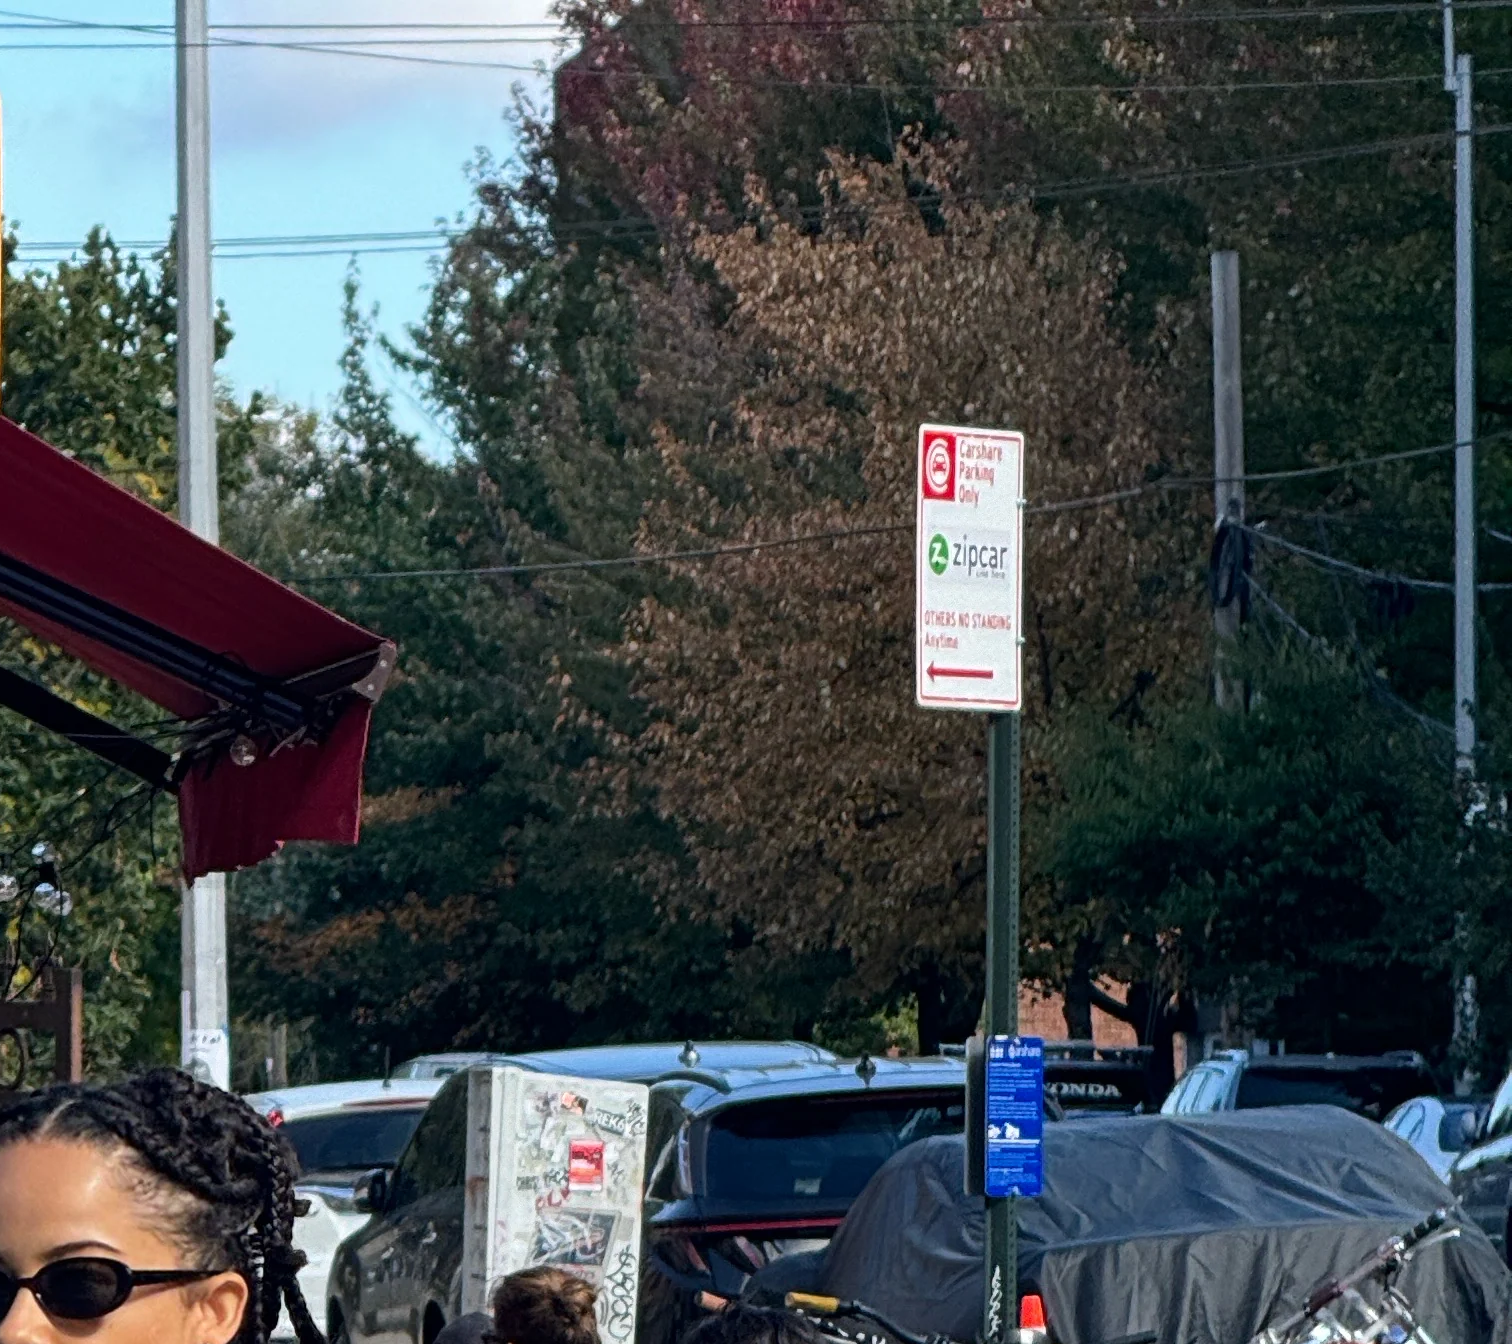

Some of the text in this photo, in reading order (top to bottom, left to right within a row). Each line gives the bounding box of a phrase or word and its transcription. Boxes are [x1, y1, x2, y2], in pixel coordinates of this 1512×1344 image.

[959, 440, 1003, 462] Carshare
[959, 461, 995, 487] Parking
[959, 484, 980, 508] Only
[953, 534, 1008, 577] zipcar
[925, 609, 1012, 631] OTHERS NO STANDING
[925, 632, 958, 650] Anytime
